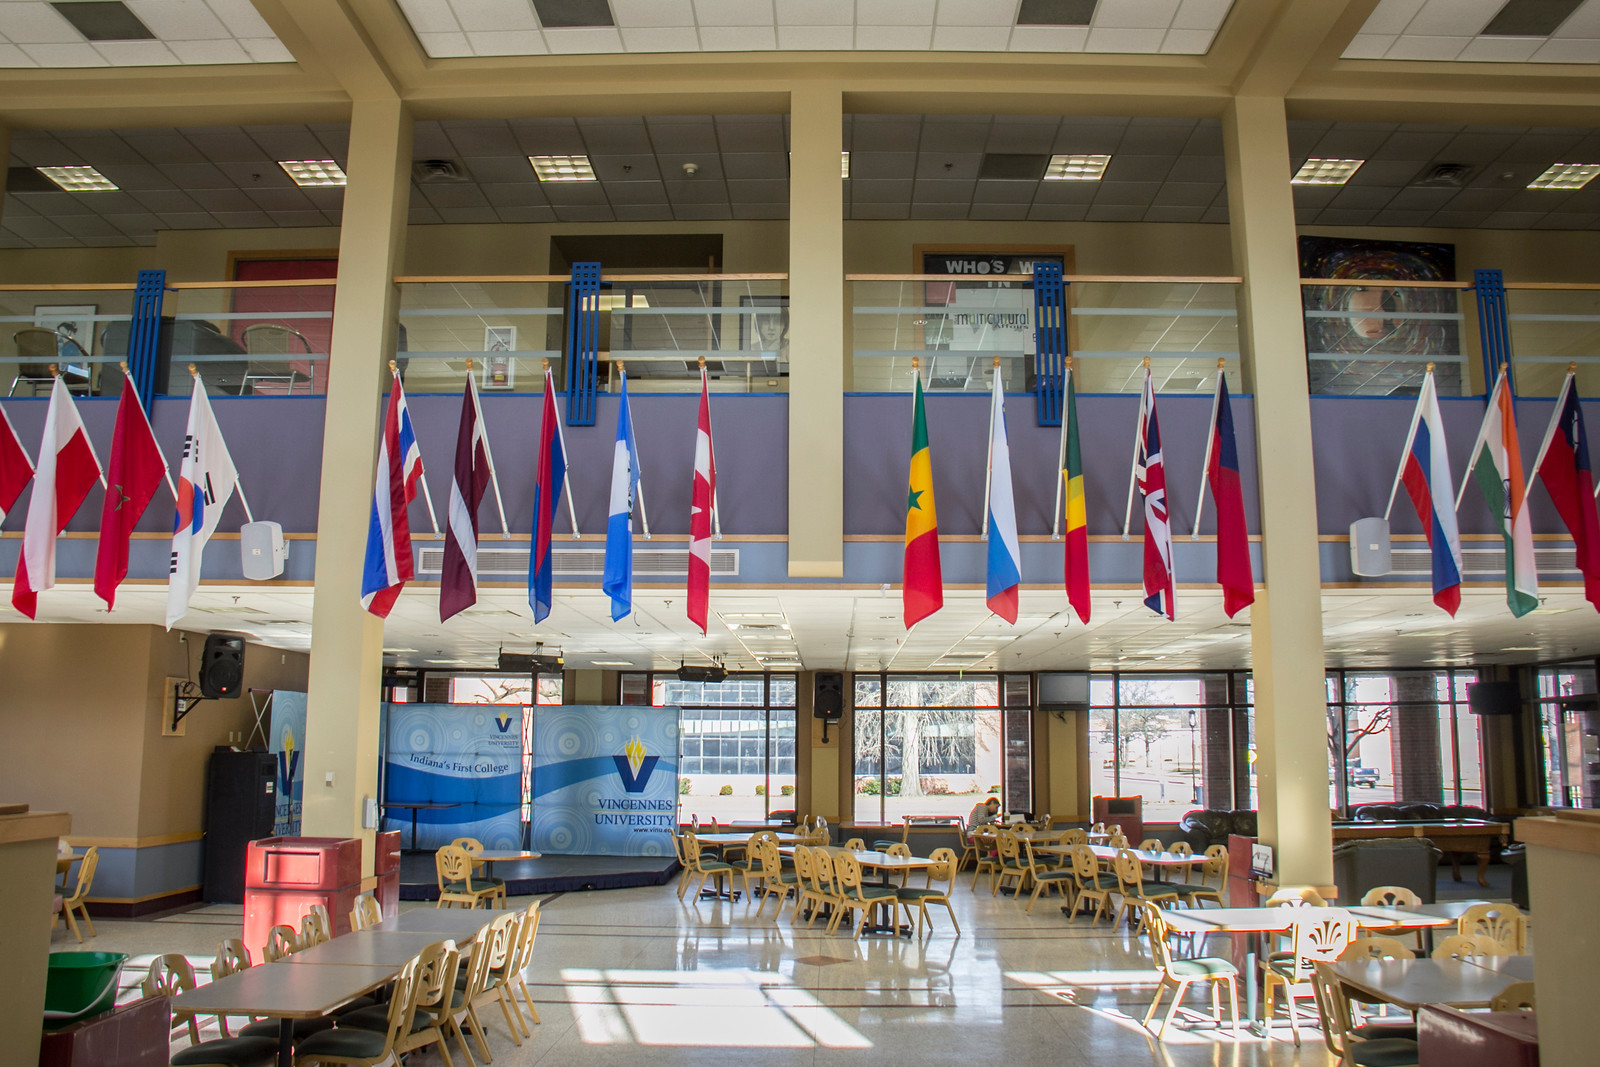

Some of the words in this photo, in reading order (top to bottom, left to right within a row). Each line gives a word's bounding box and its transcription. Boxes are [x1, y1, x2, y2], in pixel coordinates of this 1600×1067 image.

[945, 259, 1005, 274] WHO'S
[409, 753, 451, 770] Indiana's
[452, 762, 473, 773] First
[474, 763, 509, 774] College
[597, 798, 673, 811] VINCENNES
[594, 813, 675, 826] UNIVERSITY
